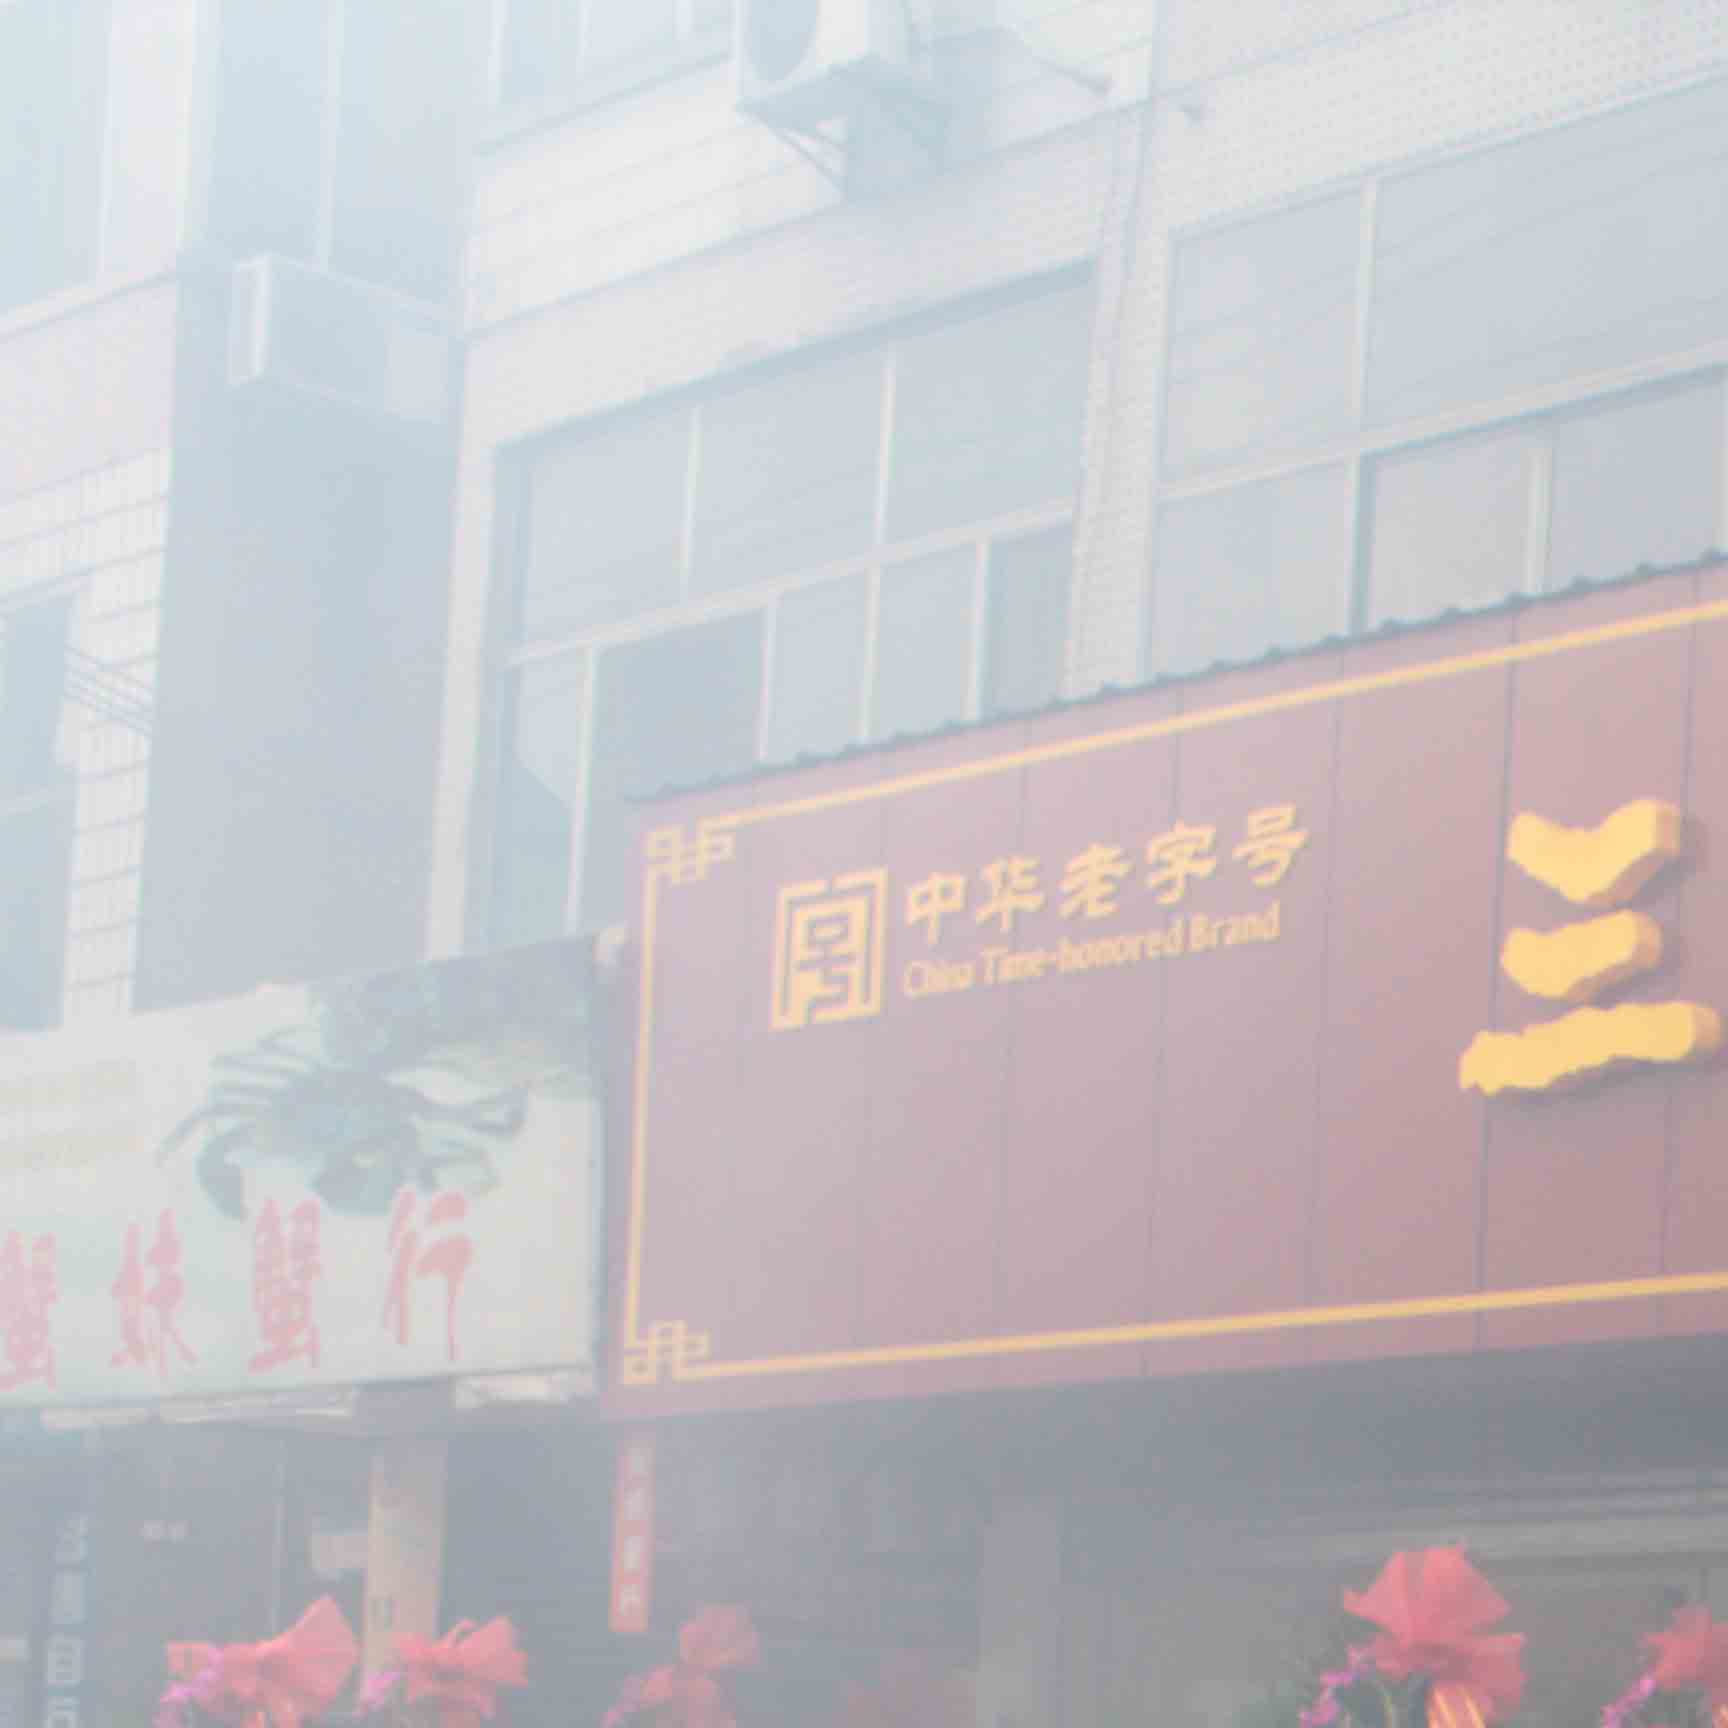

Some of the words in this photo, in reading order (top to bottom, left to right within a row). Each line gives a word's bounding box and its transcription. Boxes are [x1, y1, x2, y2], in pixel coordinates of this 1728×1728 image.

[906, 804, 1305, 944] 中华老字号
[1190, 899, 1281, 952] Brand
